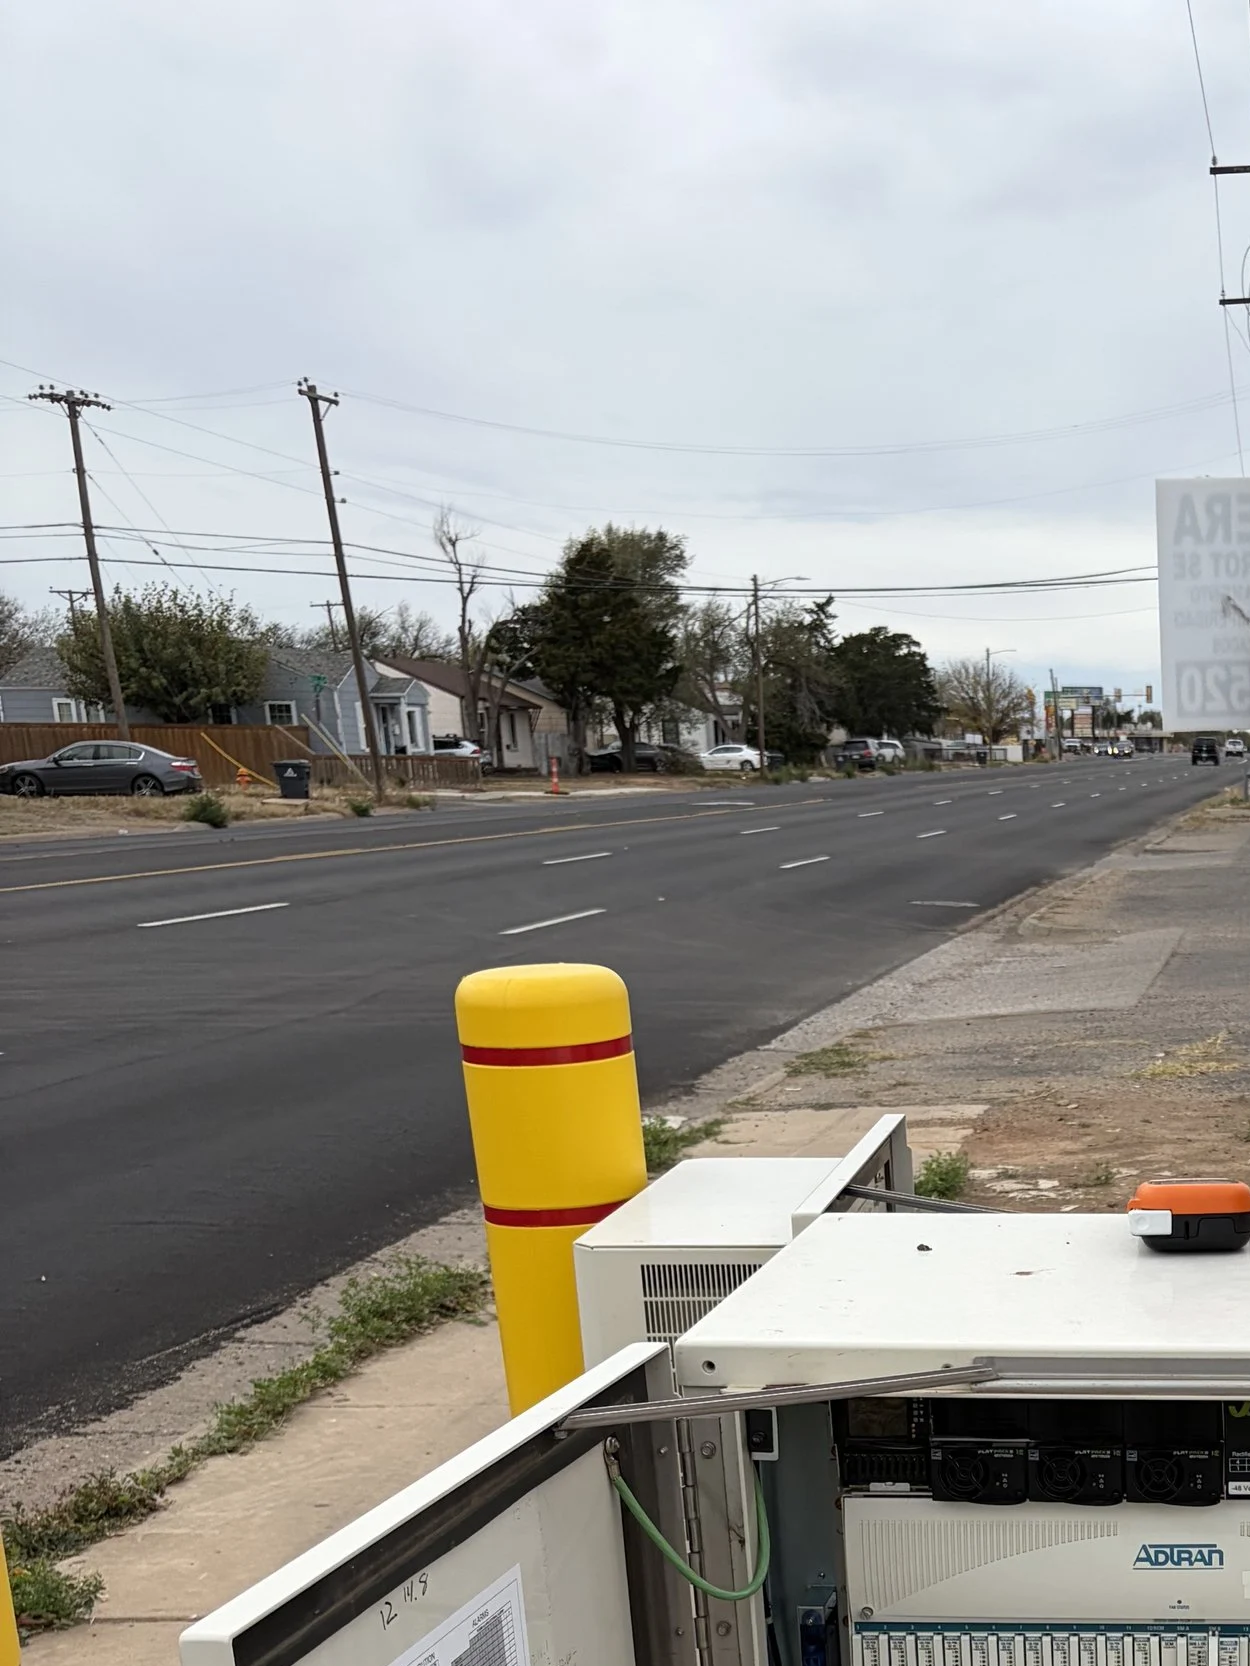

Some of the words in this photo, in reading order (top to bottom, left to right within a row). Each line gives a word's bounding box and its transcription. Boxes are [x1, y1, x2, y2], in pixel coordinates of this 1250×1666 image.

[1133, 1543, 1224, 1567] ADTRAN
[380, 1601, 398, 1630] 12
[402, 1572, 429, 1603] 14.8
